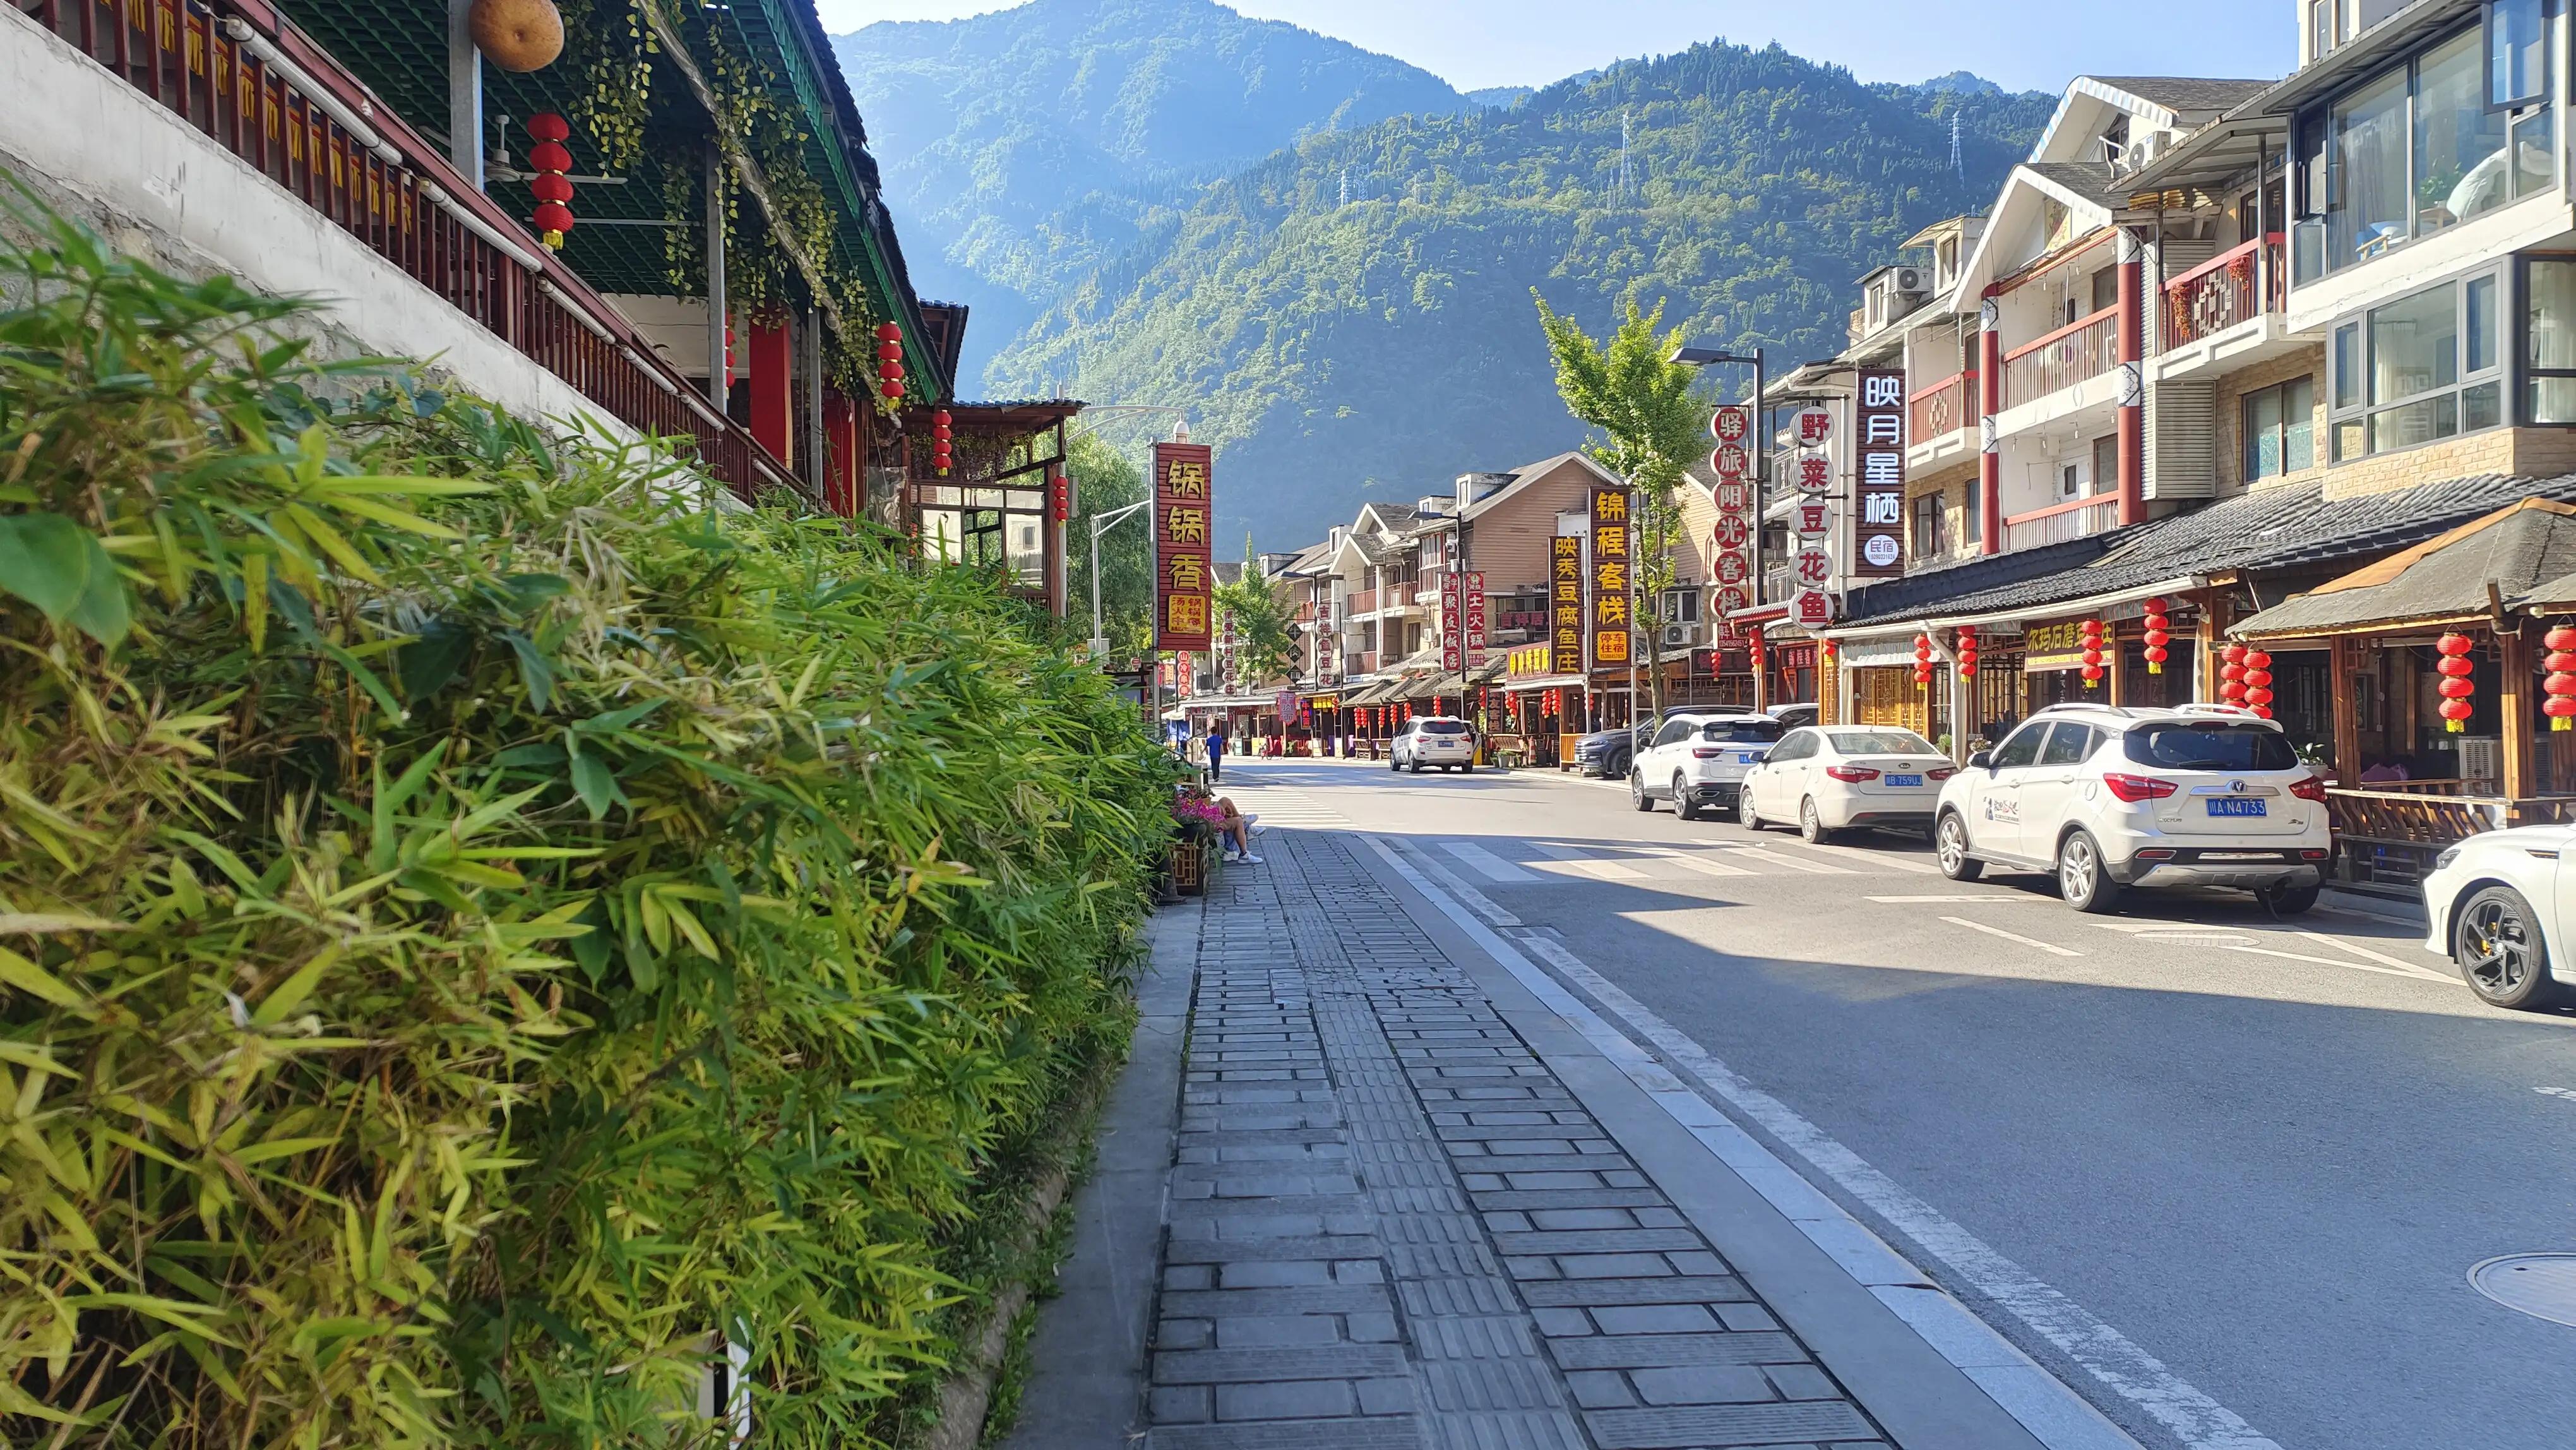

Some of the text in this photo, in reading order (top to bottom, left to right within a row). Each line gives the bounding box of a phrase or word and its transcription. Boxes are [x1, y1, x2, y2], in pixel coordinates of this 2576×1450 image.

[1718, 412, 1743, 615] 驿旅阳光客栈
[1865, 376, 1900, 524] 映月星栖
[1168, 460, 1205, 591] 锅锅香
[1596, 492, 1626, 626] 锦程客栈
[1798, 413, 1830, 623] 野菜豆花鱼
[1871, 540, 1894, 553] 民宿
[1445, 594, 1458, 668] 聚友饭店
[1469, 594, 1484, 647] 土火锅
[1555, 537, 1578, 673] 映秀豆腐鱼庄
[1601, 633, 1625, 643] 停车
[1601, 644, 1625, 653] 住宿
